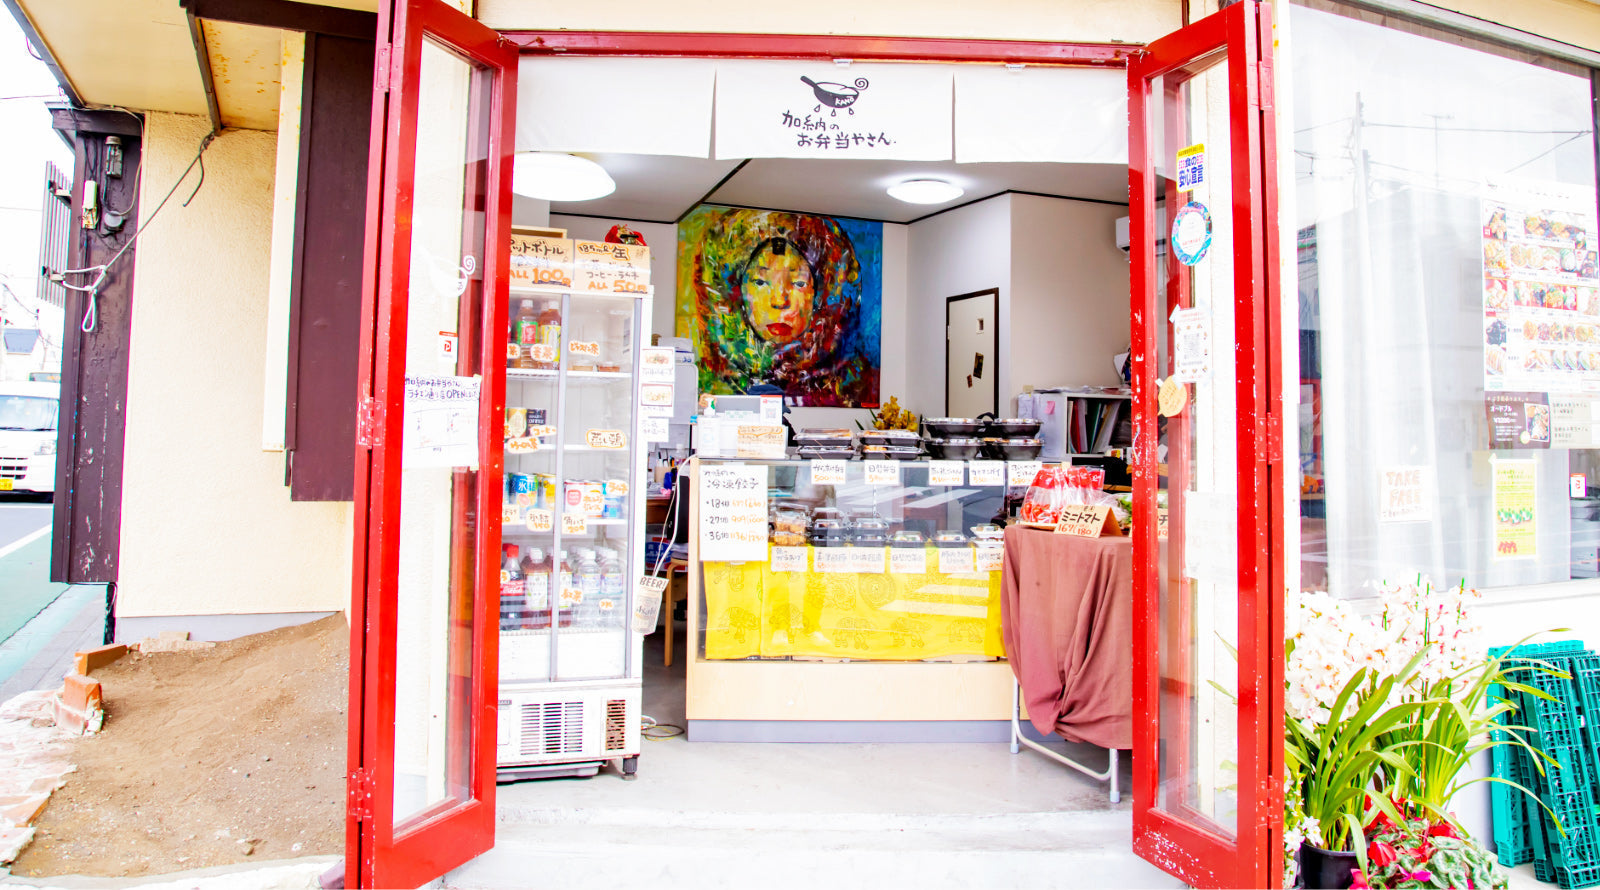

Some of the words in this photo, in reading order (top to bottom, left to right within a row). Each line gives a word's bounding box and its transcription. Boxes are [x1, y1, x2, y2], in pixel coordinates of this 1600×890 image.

[782, 110, 840, 131] 加納の
[588, 281, 608, 290] ALL
[613, 280, 646, 293] 50円
[707, 478, 759, 489] 冷凍餃子
[1386, 470, 1421, 487] TAKE
[1389, 489, 1422, 507] FREE
[1062, 512, 1101, 524] ミニトマト
[640, 576, 667, 590] BEER!
